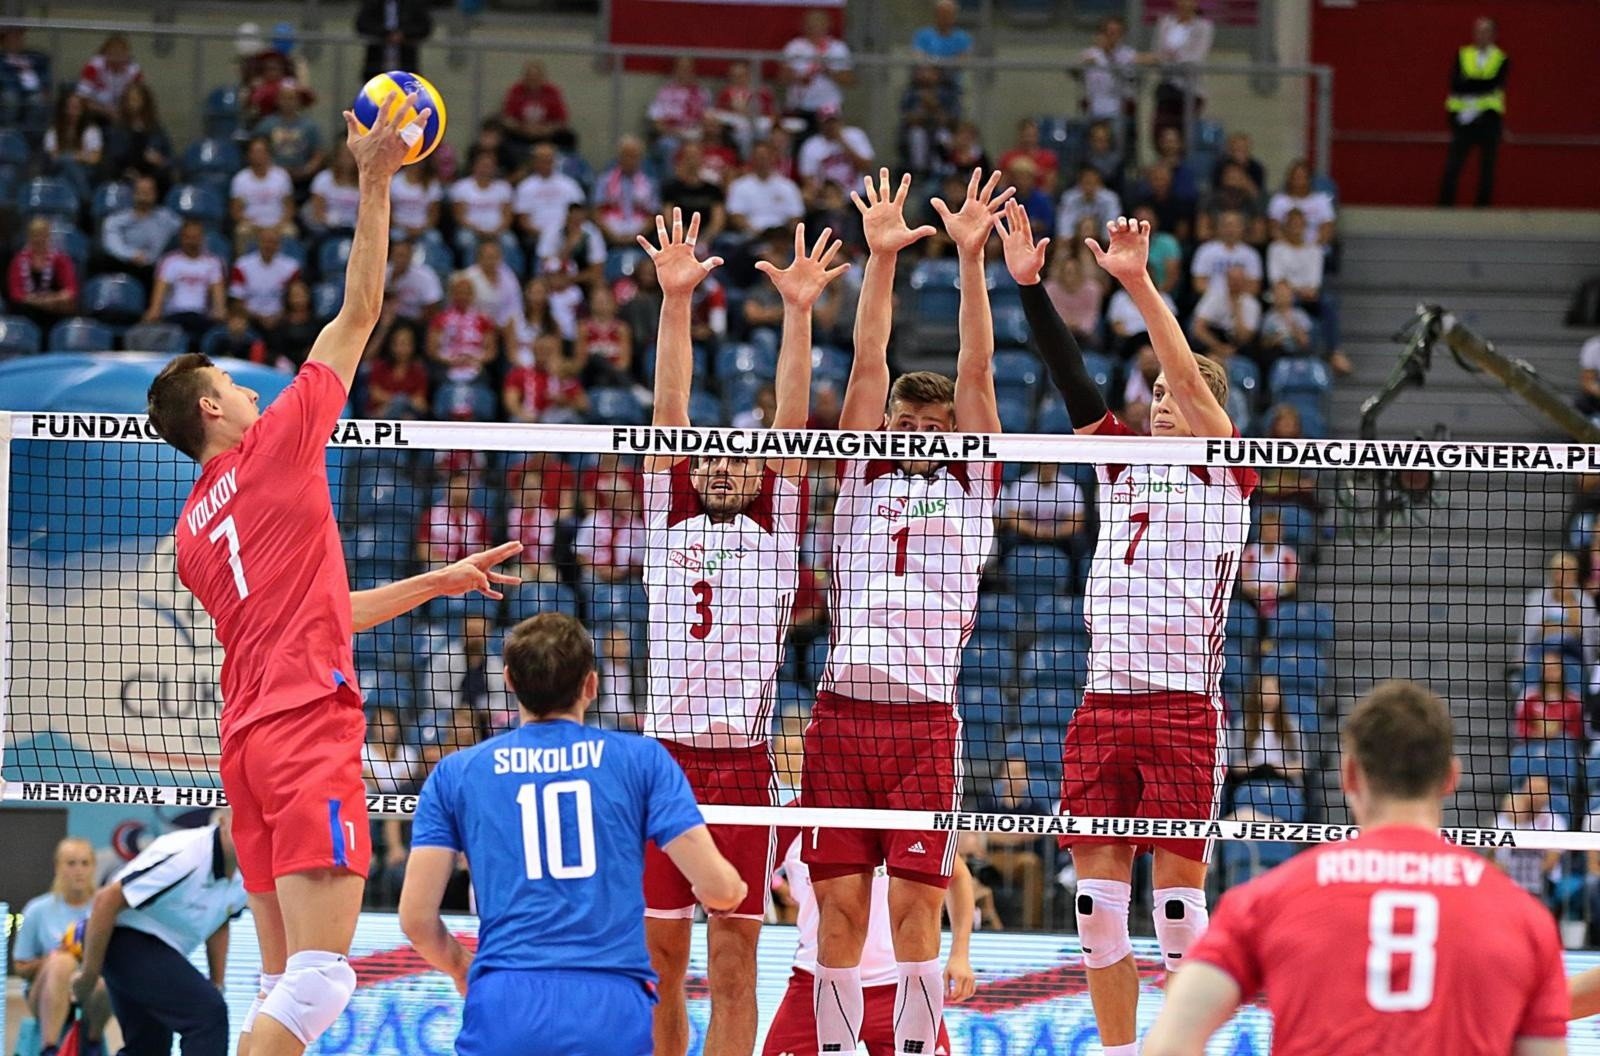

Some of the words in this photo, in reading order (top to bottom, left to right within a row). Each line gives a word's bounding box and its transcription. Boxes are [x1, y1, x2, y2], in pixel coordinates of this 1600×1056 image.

[612, 427, 998, 459] FUNDACJAWAGNERA.PL
[1205, 439, 1600, 470] FUNDACJAWAGNERA.PL
[186, 466, 239, 537] VOLKOV
[208, 514, 250, 601] 7
[891, 527, 910, 577] 1
[1123, 512, 1149, 566] 7
[689, 580, 713, 640] 3
[493, 739, 605, 775] SOKOLOV
[22, 783, 166, 805] MEMORIAŁ
[516, 779, 597, 880] 10
[933, 813, 1081, 834] MEMORIAŁ
[1091, 818, 1223, 838] HUBERTA
[1316, 849, 1486, 887] RODICHEV
[1366, 889, 1440, 1012] 8
